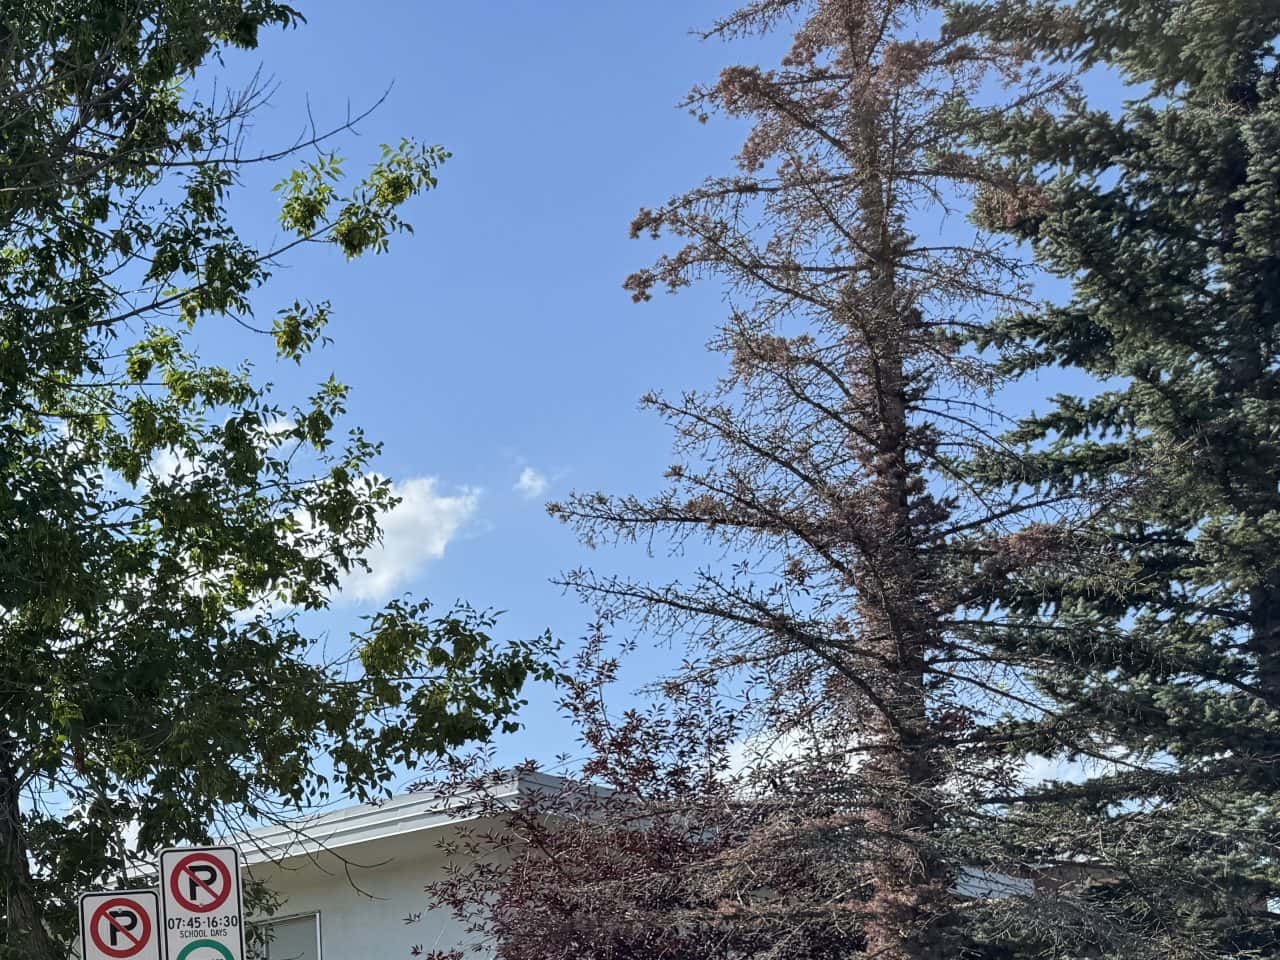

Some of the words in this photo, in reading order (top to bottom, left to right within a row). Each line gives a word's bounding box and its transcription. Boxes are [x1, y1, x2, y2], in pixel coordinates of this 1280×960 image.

[167, 915, 238, 930] 07:45-16:30
[179, 929, 207, 938] SCHOOL
[210, 928, 228, 937] DAYS
